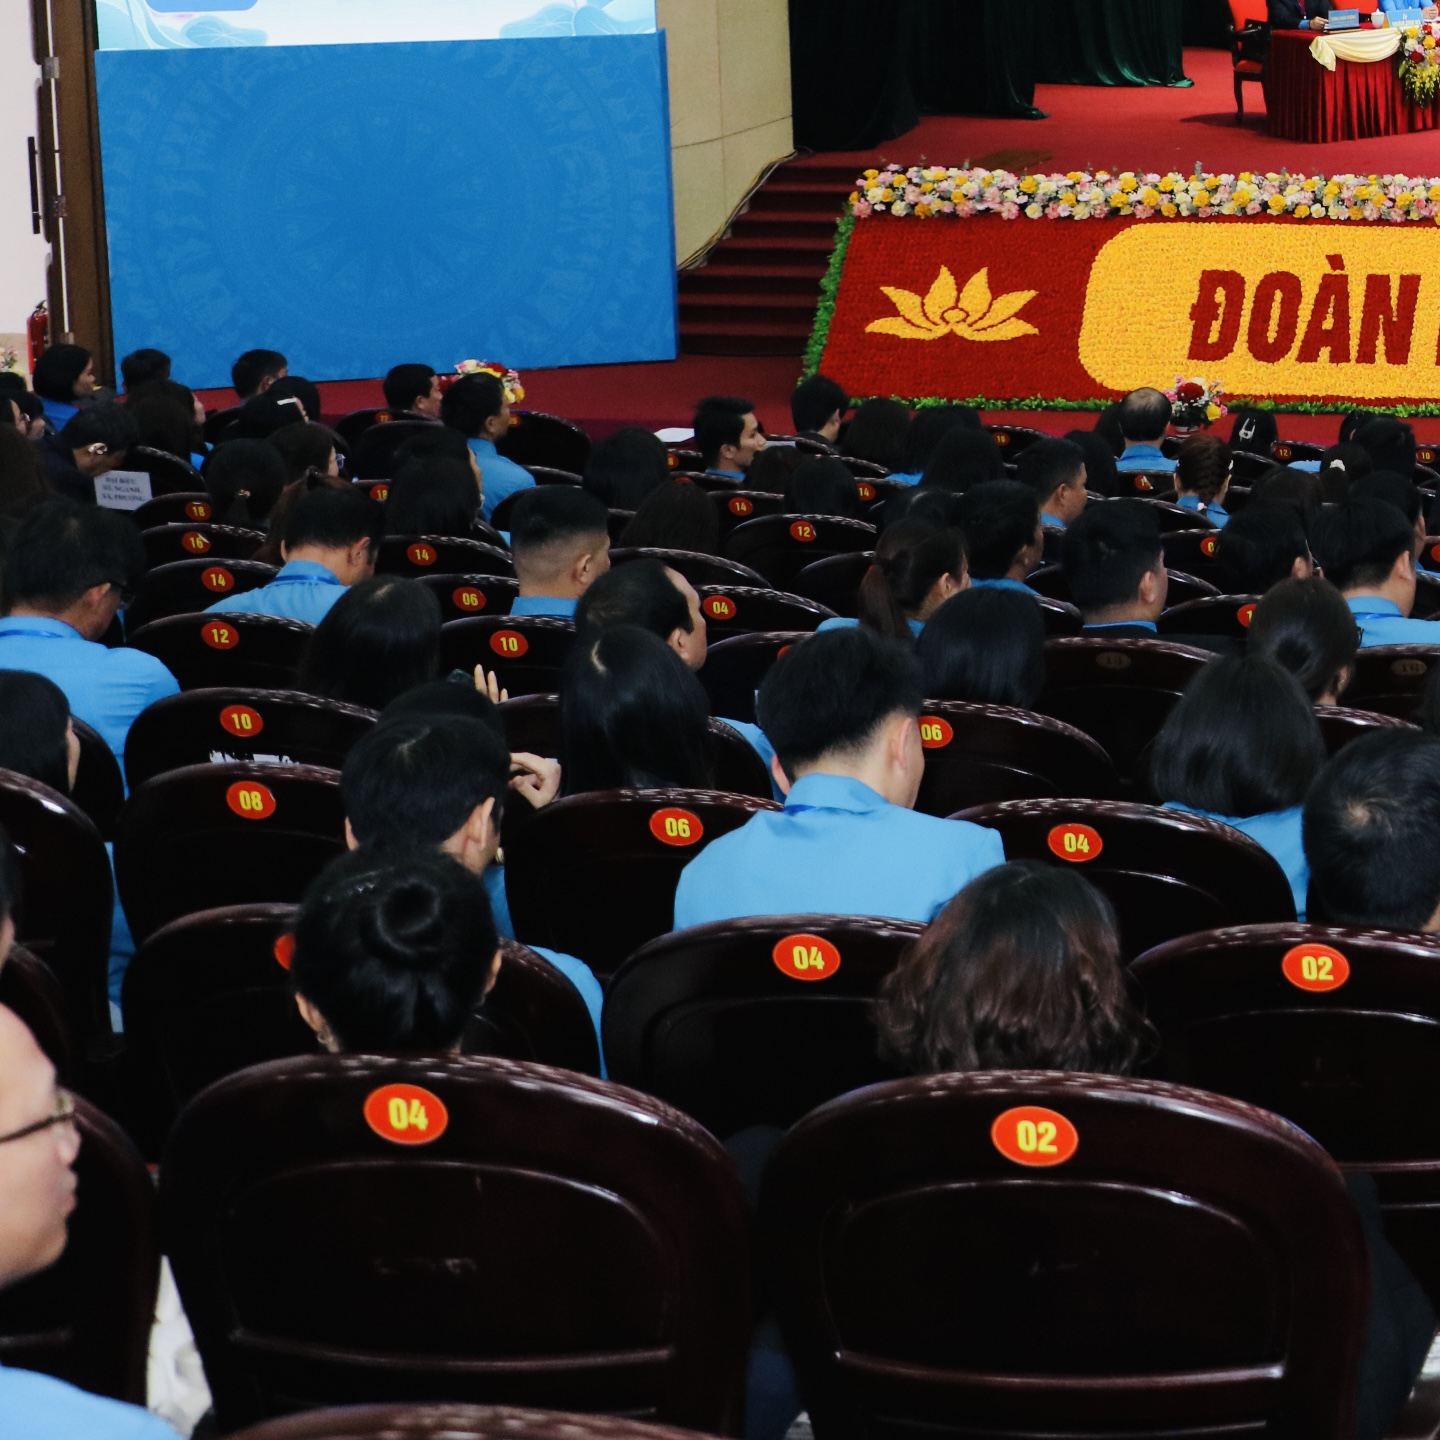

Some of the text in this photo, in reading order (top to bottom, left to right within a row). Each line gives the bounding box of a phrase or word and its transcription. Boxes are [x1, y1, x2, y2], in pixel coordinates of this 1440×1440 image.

[1189, 254, 1421, 365] ĐOÀN
[210, 574, 225, 586] 14
[463, 593, 478, 606] 06
[713, 602, 728, 614] 04
[212, 629, 229, 643] 12
[500, 637, 518, 651] 10
[232, 714, 252, 729] 10
[239, 790, 263, 810] 08
[1064, 833, 1089, 853] 04
[793, 946, 825, 970] 04
[1302, 956, 1334, 980] 02
[388, 1098, 428, 1130] 04
[1017, 1120, 1057, 1153] 02
